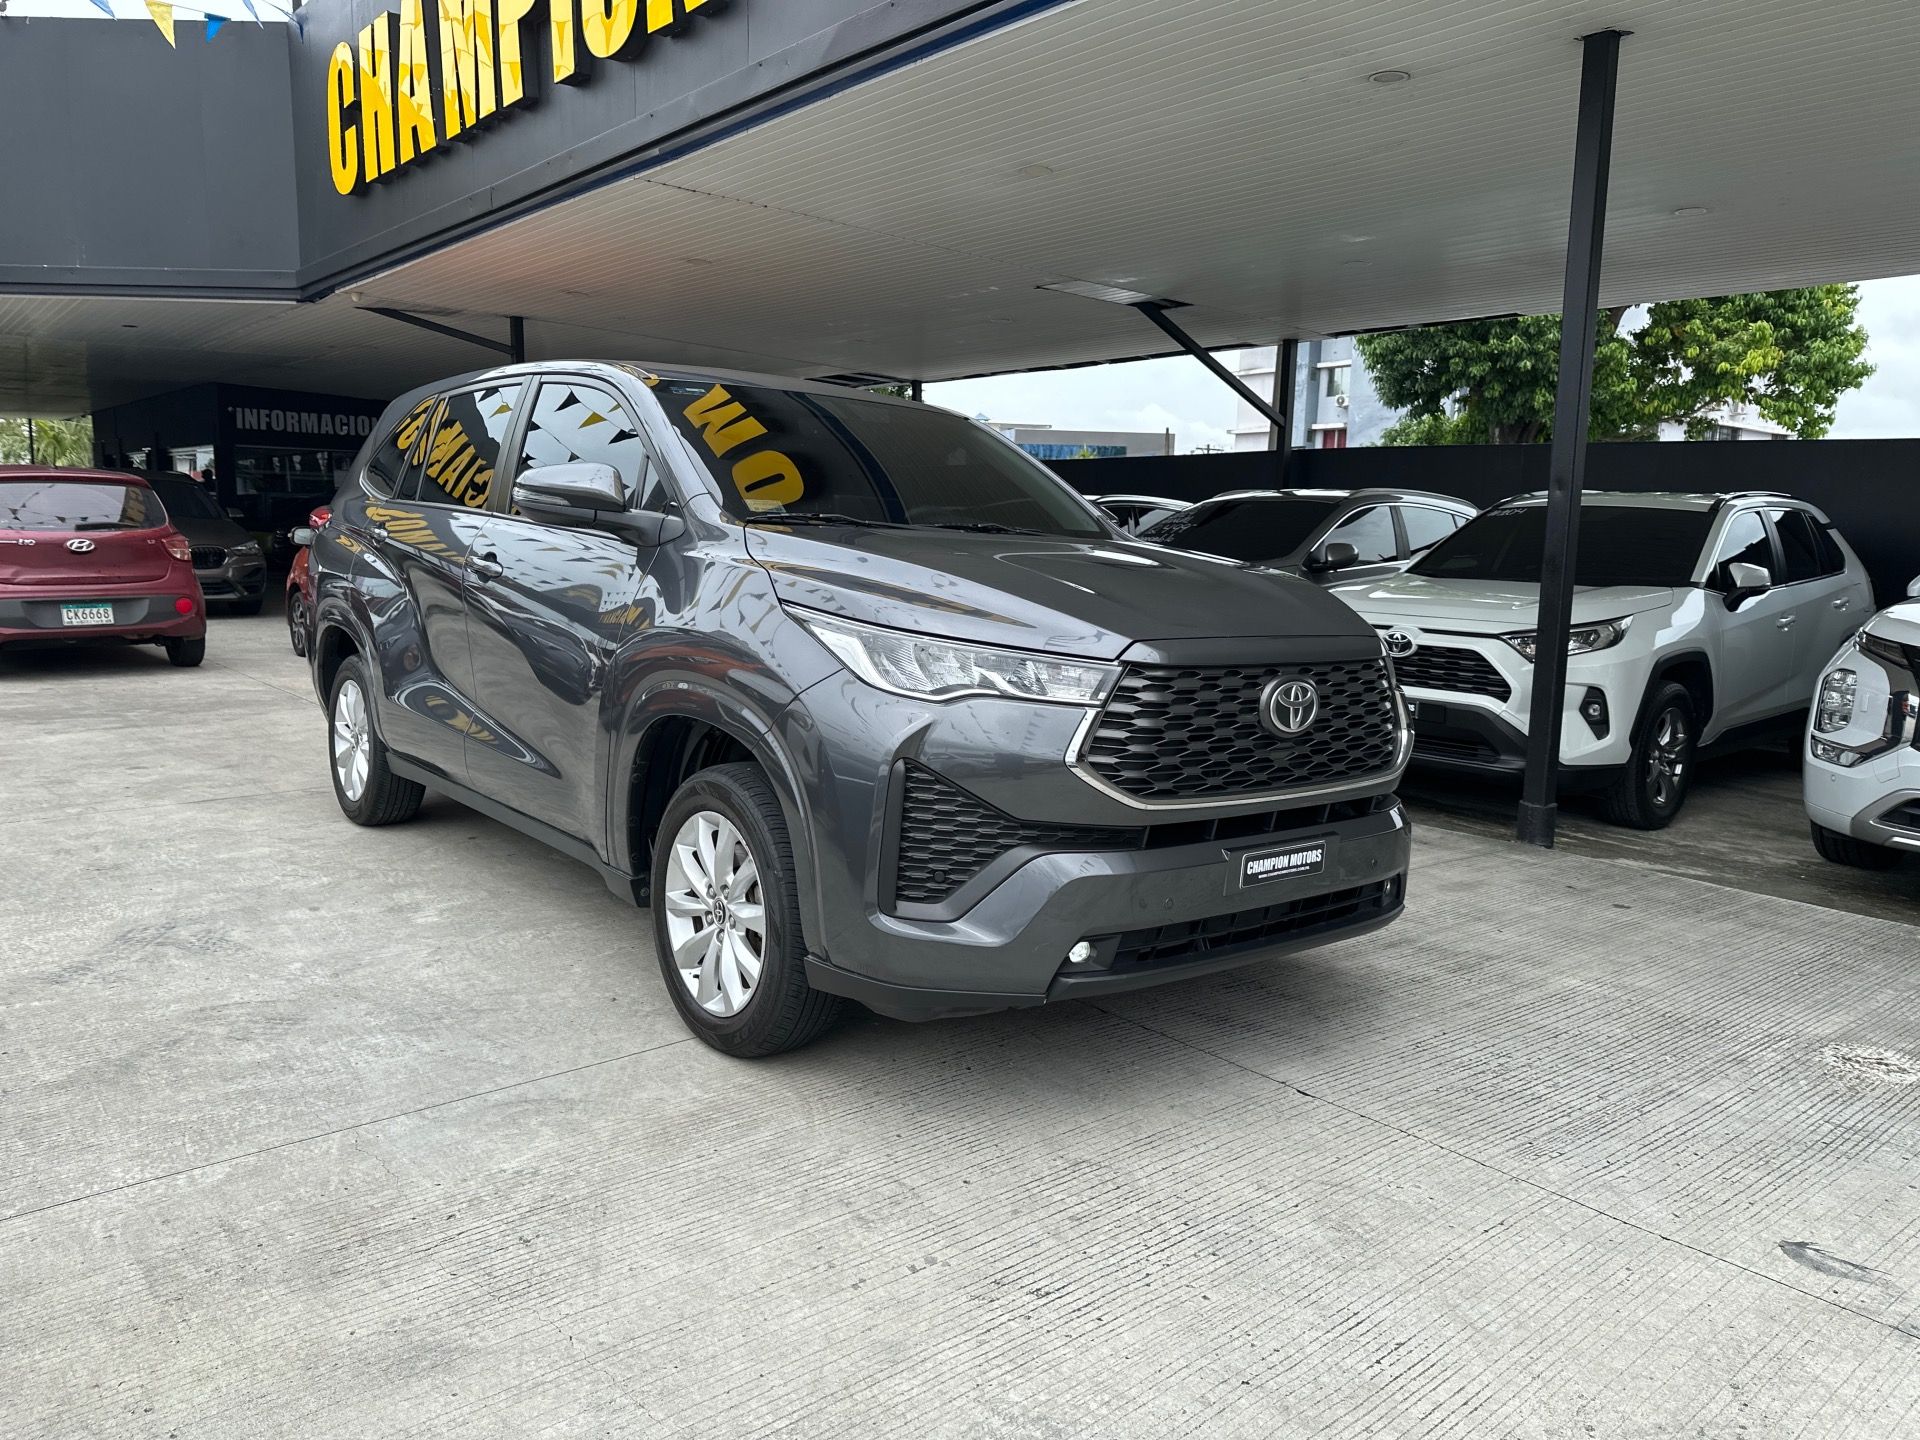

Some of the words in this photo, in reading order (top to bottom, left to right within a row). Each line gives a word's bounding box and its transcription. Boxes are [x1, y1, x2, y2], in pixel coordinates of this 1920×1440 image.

[327, 0, 711, 195] CHAMP
[236, 407, 378, 437] INFORMACIO
[66, 608, 110, 620] CK6668
[1247, 855, 1289, 875] CHAMPION
[1290, 849, 1322, 867] MOTORS
